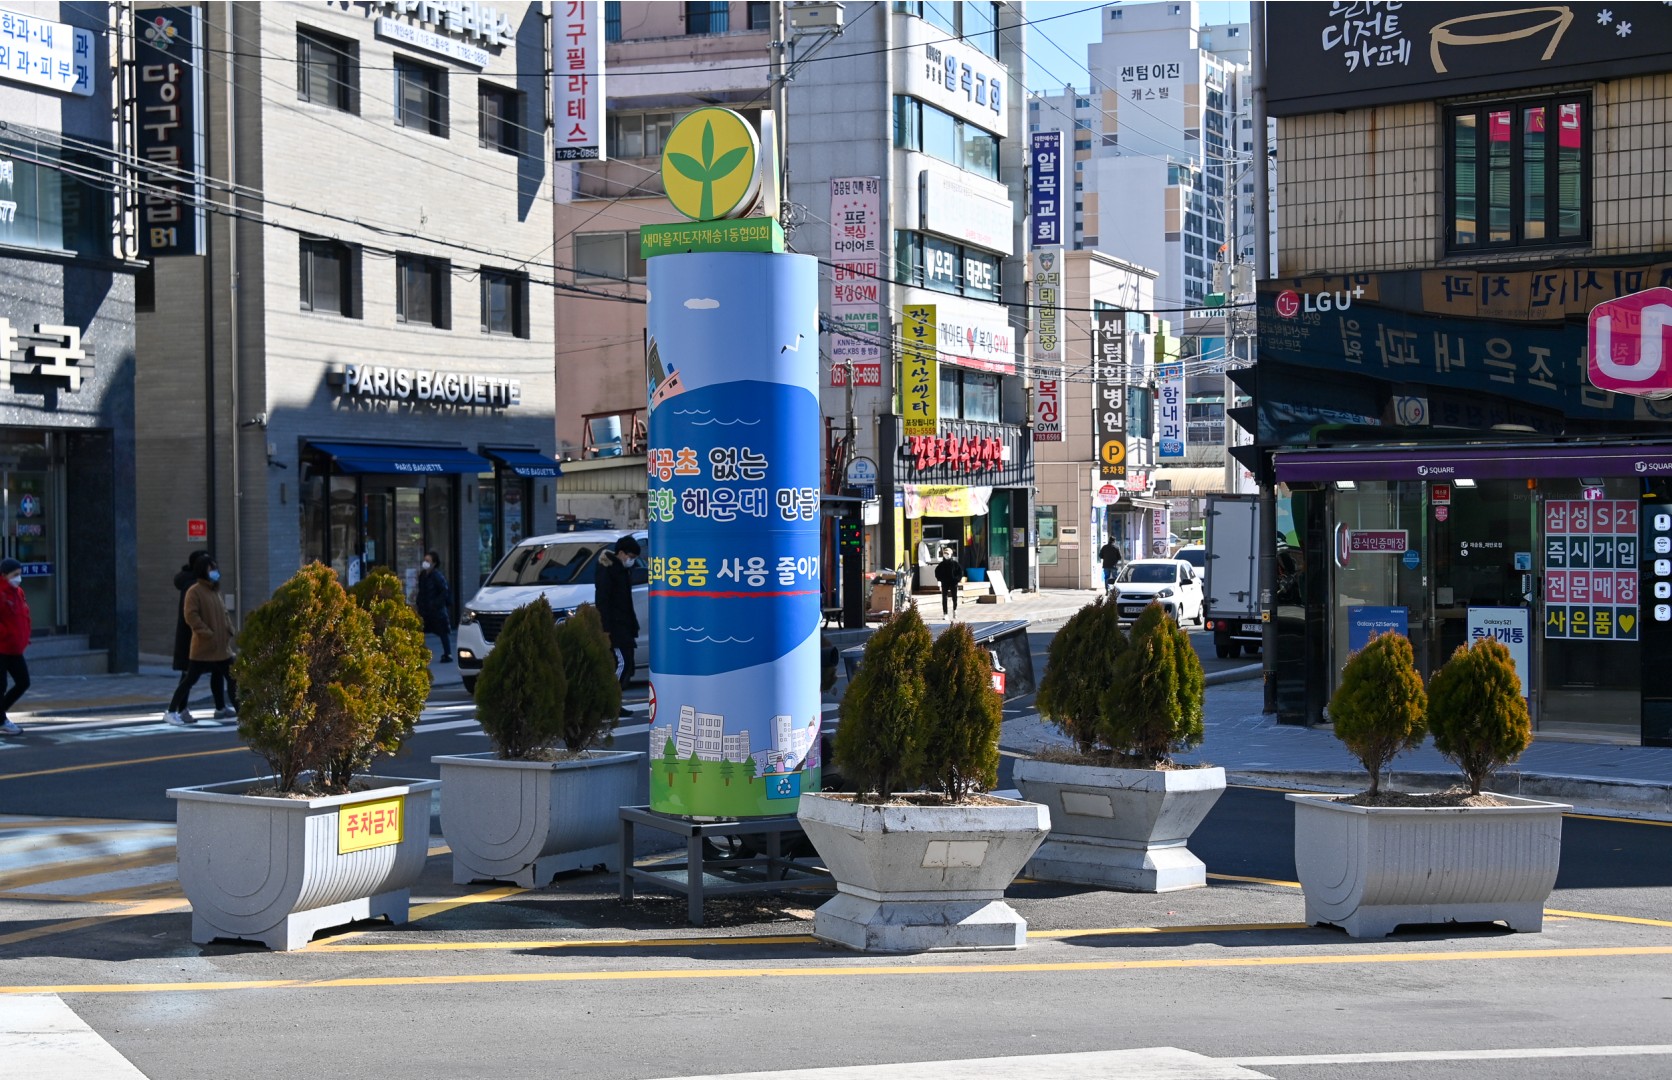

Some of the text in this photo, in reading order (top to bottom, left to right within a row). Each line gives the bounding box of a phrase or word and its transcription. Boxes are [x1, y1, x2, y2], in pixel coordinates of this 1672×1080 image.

[1322, 11, 1402, 51] 디저트
[1344, 38, 1411, 73] 카페
[945, 54, 1001, 116] 알곡교회
[1037, 152, 1056, 241] 알곡교회
[845, 210, 866, 224] 프로
[150, 227, 177, 247] B1
[642, 225, 770, 248] 새마을지도자재송1동협의회
[845, 225, 866, 239] 복싱
[835, 240, 875, 253] 다이어트
[935, 249, 953, 282] 우리
[1035, 273, 1060, 286] 우리
[845, 313, 878, 321] NAVER
[345, 364, 521, 406] PARIS BAGUETTE
[1038, 380, 1058, 422] 복싱
[1163, 387, 1180, 439] 함내과
[1037, 422, 1058, 432] GYM
[395, 463, 443, 472] PARIS BAGUETTE
[709, 447, 768, 481] 없는
[1102, 466, 1125, 475] 주차장
[1429, 466, 1454, 474] SQUARE
[681, 487, 768, 522] 해운대
[1352, 537, 1405, 550] 공식인증매장
[1547, 541, 1635, 565] 즉시가입
[717, 556, 769, 587] 사용
[1548, 576, 1636, 601] 전문매장
[1471, 627, 1525, 643] 즉시개통
[1547, 611, 1612, 635] 사은품
[346, 806, 398, 839] 주차금지
